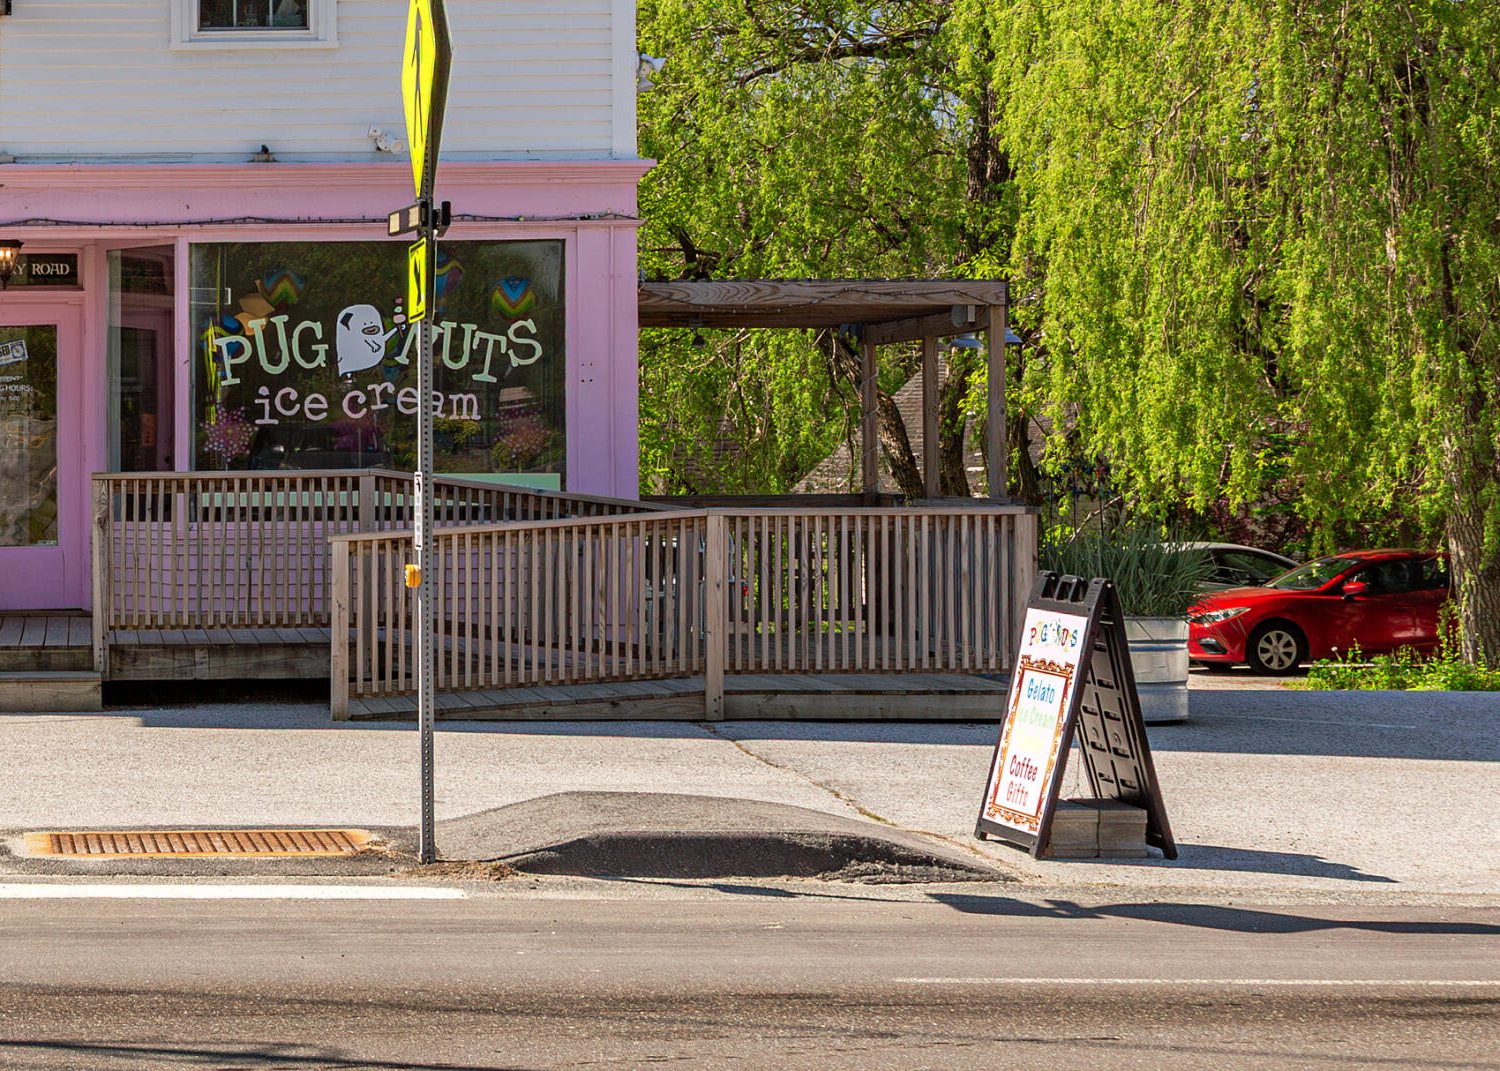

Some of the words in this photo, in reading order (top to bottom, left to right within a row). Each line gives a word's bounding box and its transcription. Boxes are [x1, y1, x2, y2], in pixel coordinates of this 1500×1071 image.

[32, 263, 70, 275] ROAD
[214, 314, 329, 387] PUG
[5, 384, 33, 392] HOURS:
[254, 385, 328, 425] ice
[342, 381, 482, 421] cream
[1027, 677, 1056, 704] Gelato
[1010, 754, 1038, 781] Coffee
[1006, 780, 1028, 806] Gifts
